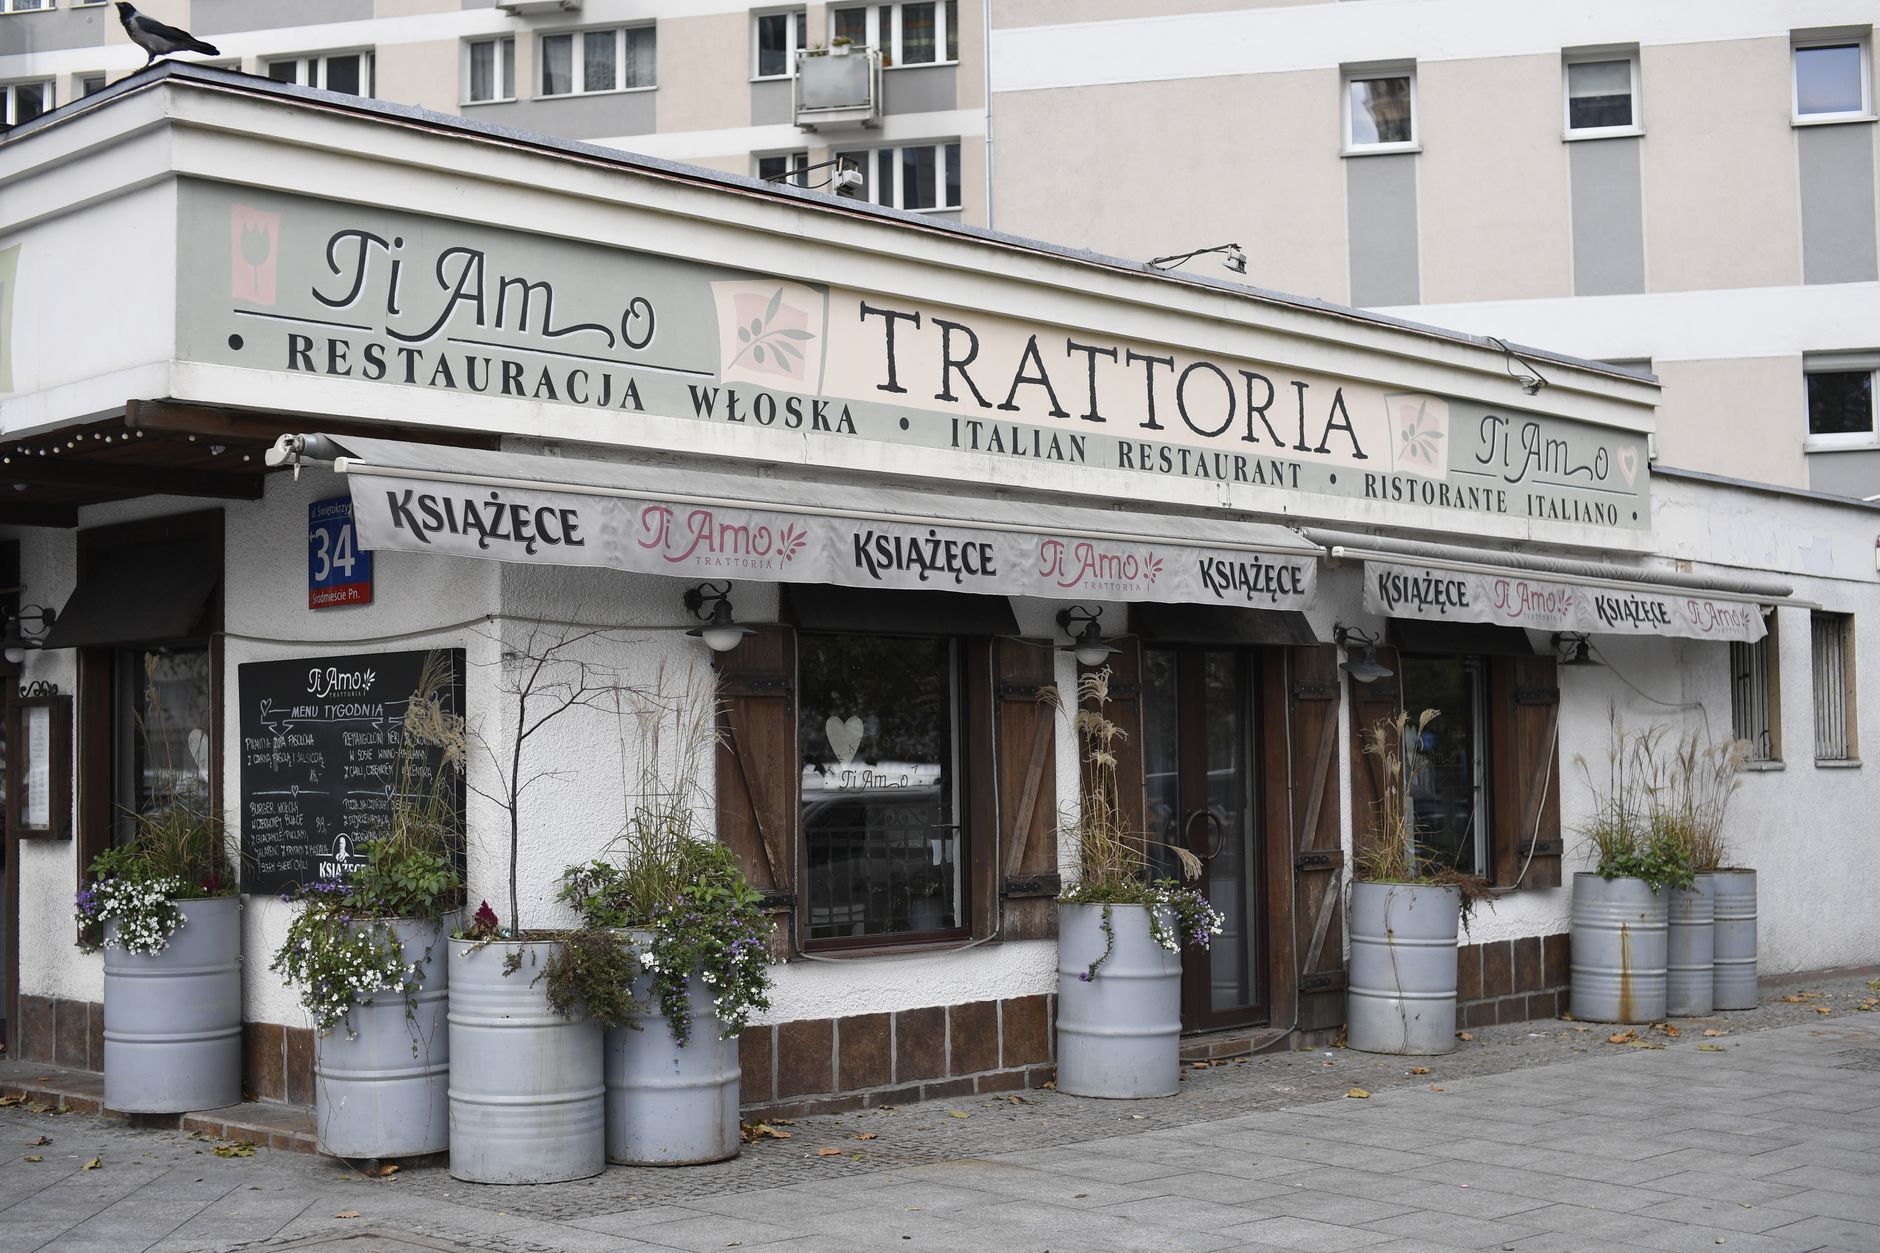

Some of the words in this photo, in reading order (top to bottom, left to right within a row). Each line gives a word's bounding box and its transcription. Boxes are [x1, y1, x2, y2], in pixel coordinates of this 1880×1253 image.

[312, 229, 403, 315] Ti
[860, 300, 1368, 460] TRATTORIA
[287, 333, 646, 411] RESTAURACJA
[688, 384, 858, 434] WŁOSKA
[951, 417, 1086, 463] ITALIAN
[1118, 439, 1302, 488] RESTAURANT
[1364, 472, 1508, 514] RISTORANTE
[1527, 494, 1618, 527] ITALIANO
[1475, 414, 1509, 468] Ti
[315, 523, 355, 581] 34
[386, 490, 586, 555] KSIĄŻĘCE
[637, 505, 673, 550] Ti
[663, 509, 773, 563] Amo
[853, 529, 997, 583] KSIĄŻĘCE
[1038, 539, 1065, 578] Ti
[1056, 542, 1139, 588] Amo
[1199, 555, 1305, 604] KSIĄŻĘCE
[695, 556, 773, 570] TRATTORIA
[348, 588, 361, 600] Pn.
[1083, 580, 1141, 592] TRATTORIA
[1378, 570, 1470, 614] KSIĄŻĘCE
[1494, 579, 1511, 609] Ti
[1506, 581, 1556, 618] Amo
[1595, 593, 1672, 630] KSIĄŻĘCE
[1701, 601, 1741, 633] Amo
[307, 668, 322, 692] Ti
[316, 667, 362, 698] Amo
[291, 706, 319, 718] MENU
[324, 704, 384, 719] TYGODNIA
